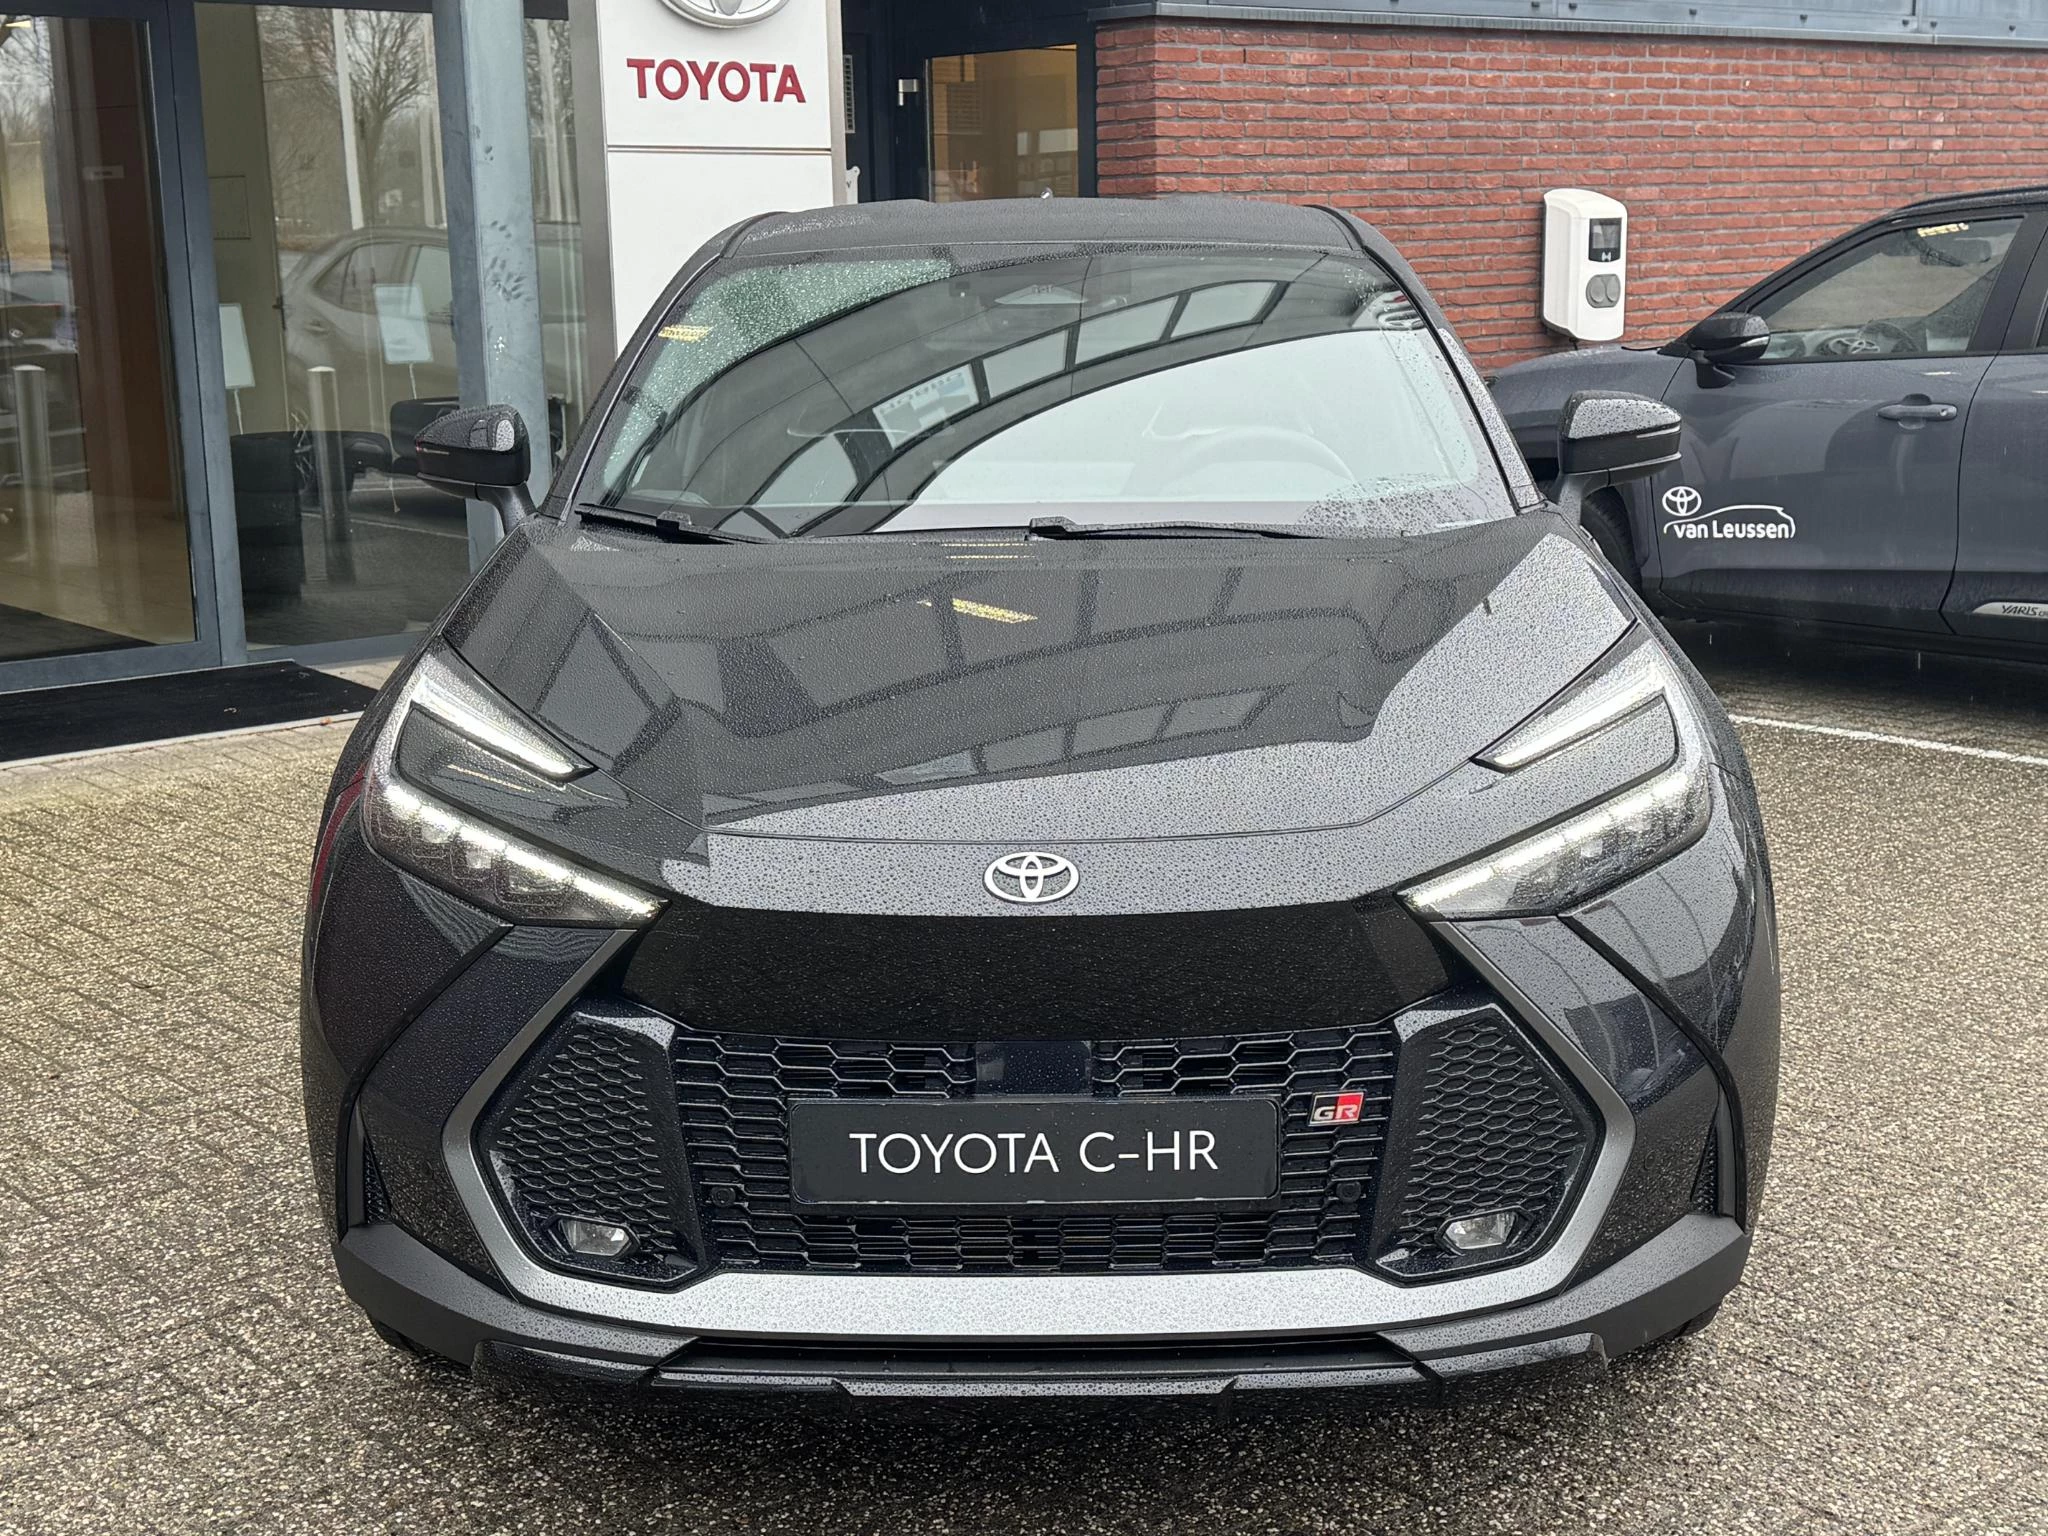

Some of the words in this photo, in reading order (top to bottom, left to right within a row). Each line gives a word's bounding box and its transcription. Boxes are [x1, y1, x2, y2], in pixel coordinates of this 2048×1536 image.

[626, 58, 806, 103] TOYOTA
[1673, 523, 1709, 539] van
[1712, 520, 1790, 539] Leussen
[2002, 604, 2038, 616] YARIS
[1313, 1103, 1359, 1121] GR
[849, 1132, 1060, 1176] TOYOTA
[1078, 1129, 1219, 1173] C-HR
